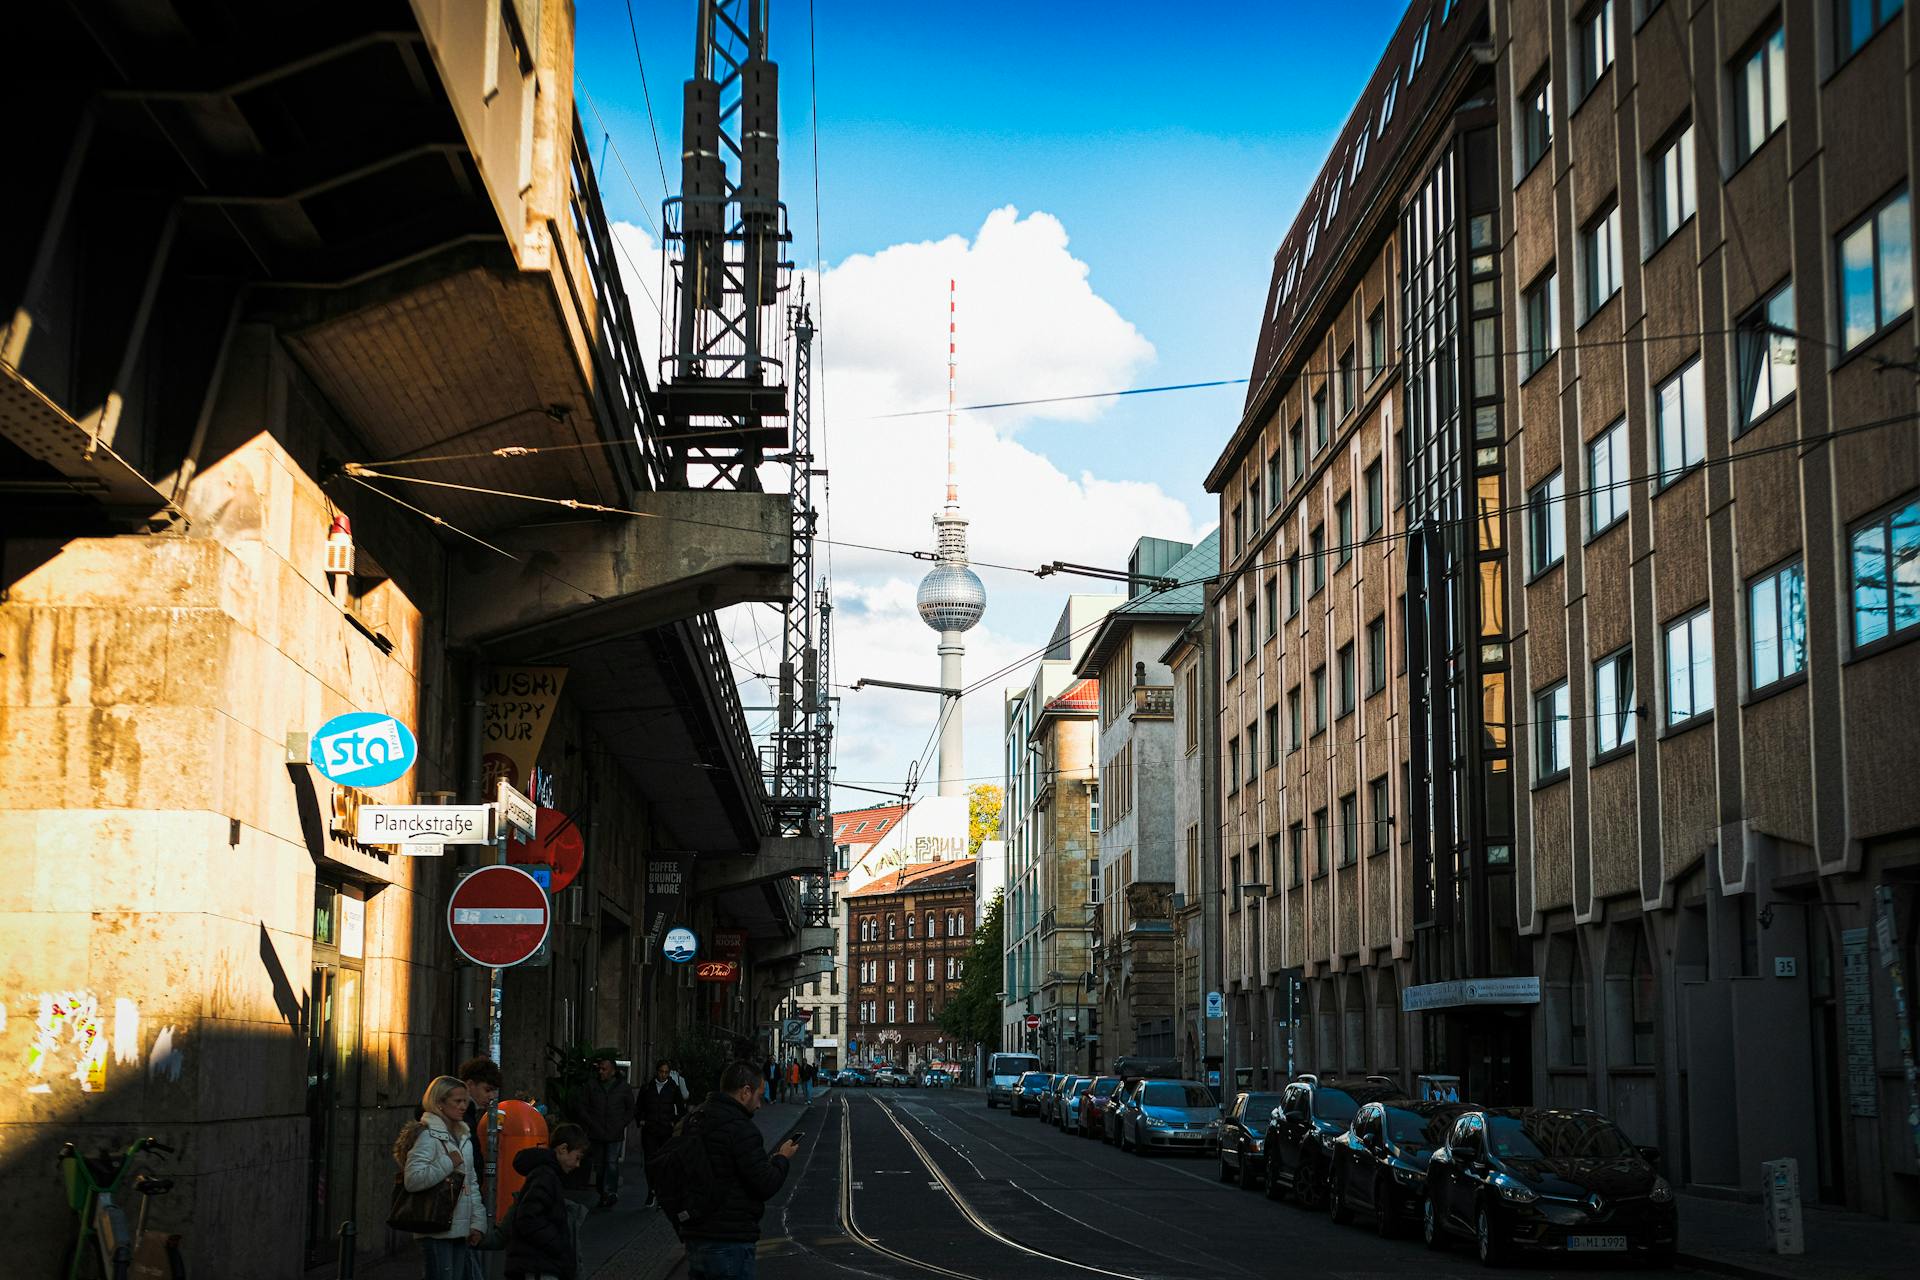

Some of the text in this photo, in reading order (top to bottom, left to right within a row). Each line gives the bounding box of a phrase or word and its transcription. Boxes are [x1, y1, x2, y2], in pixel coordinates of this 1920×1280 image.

[482, 702, 545, 720] APPY
[482, 722, 532, 741] OUR
[375, 814, 473, 835] Planckstraße
[649, 861, 679, 872] COFFEE
[648, 872, 682, 884] BRUNCH
[648, 883, 680, 894] & MORE
[1778, 960, 1793, 974] 35
[1601, 1236, 1626, 1248] 1992
